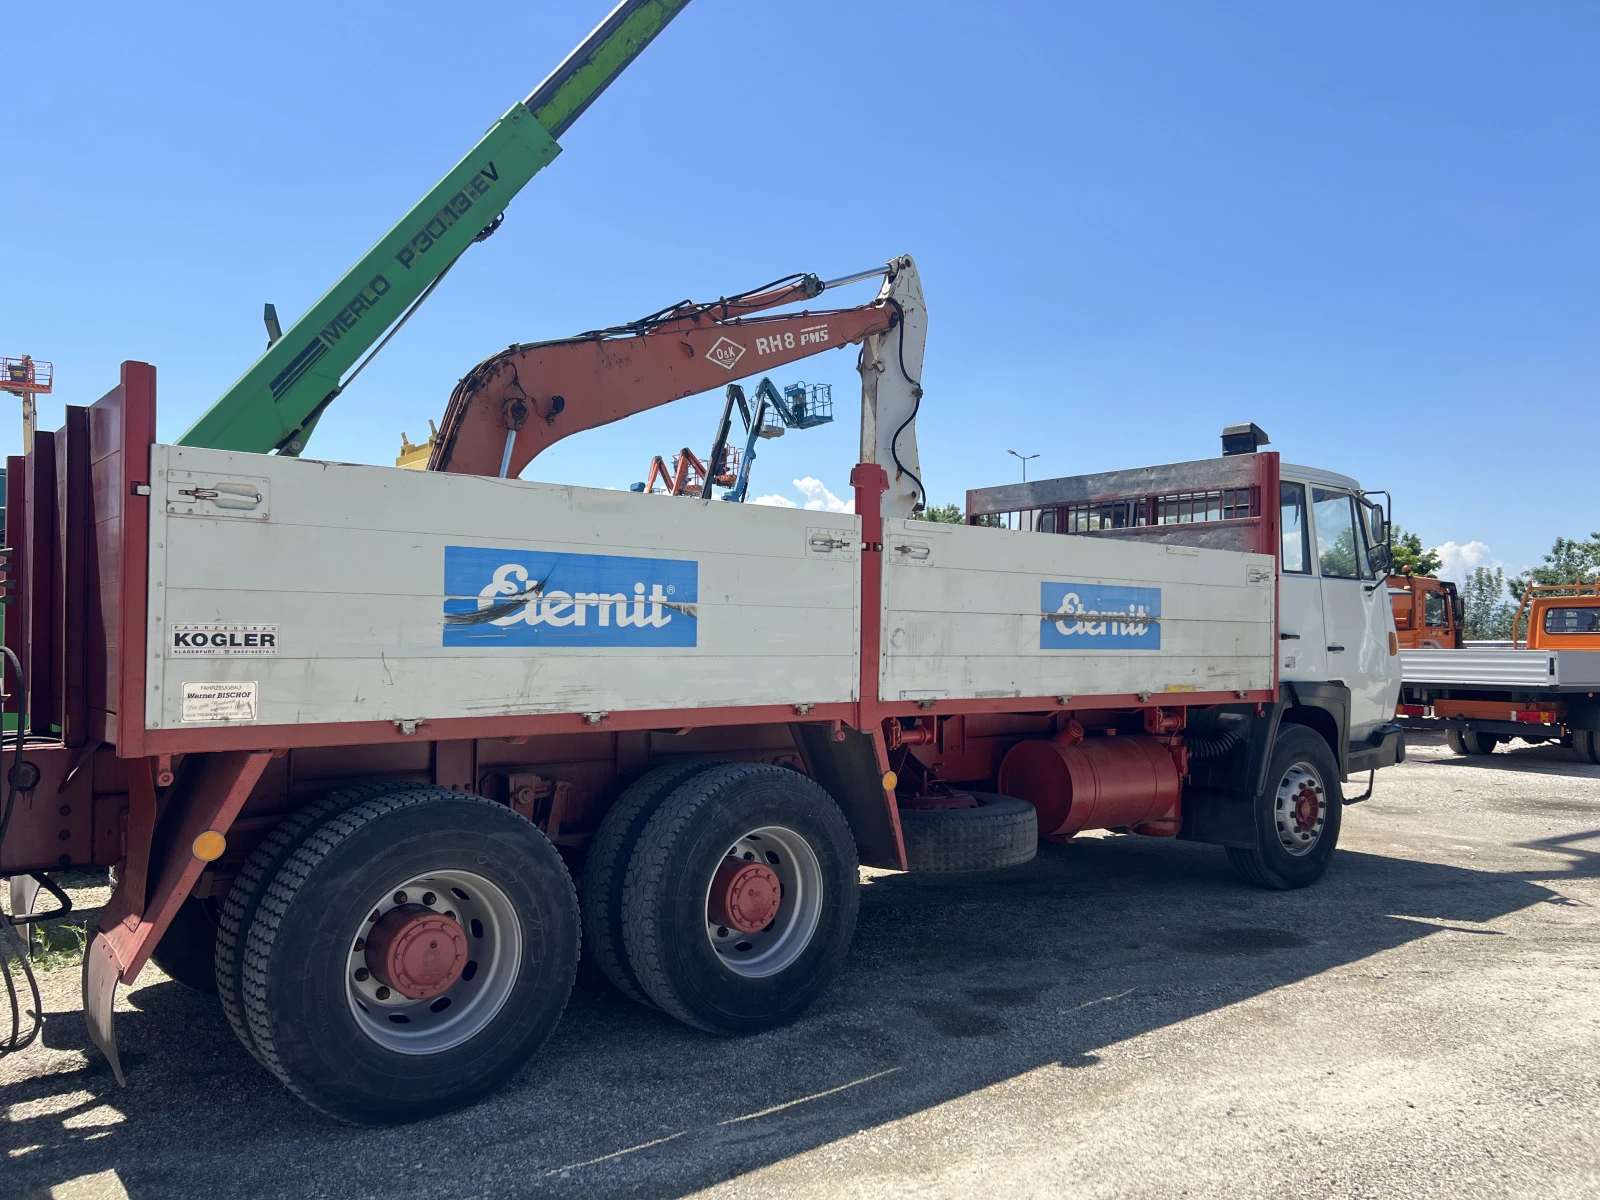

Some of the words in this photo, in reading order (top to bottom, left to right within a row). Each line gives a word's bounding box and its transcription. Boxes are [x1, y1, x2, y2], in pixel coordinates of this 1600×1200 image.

[319, 273, 391, 347] MERLO
[800, 329, 829, 346] PMS
[716, 345, 736, 360] O&K
[477, 563, 672, 628] Eternit
[1055, 592, 1149, 636] Eternit
[174, 632, 276, 647] KOGLER
[216, 691, 252, 699] BISCHOF
